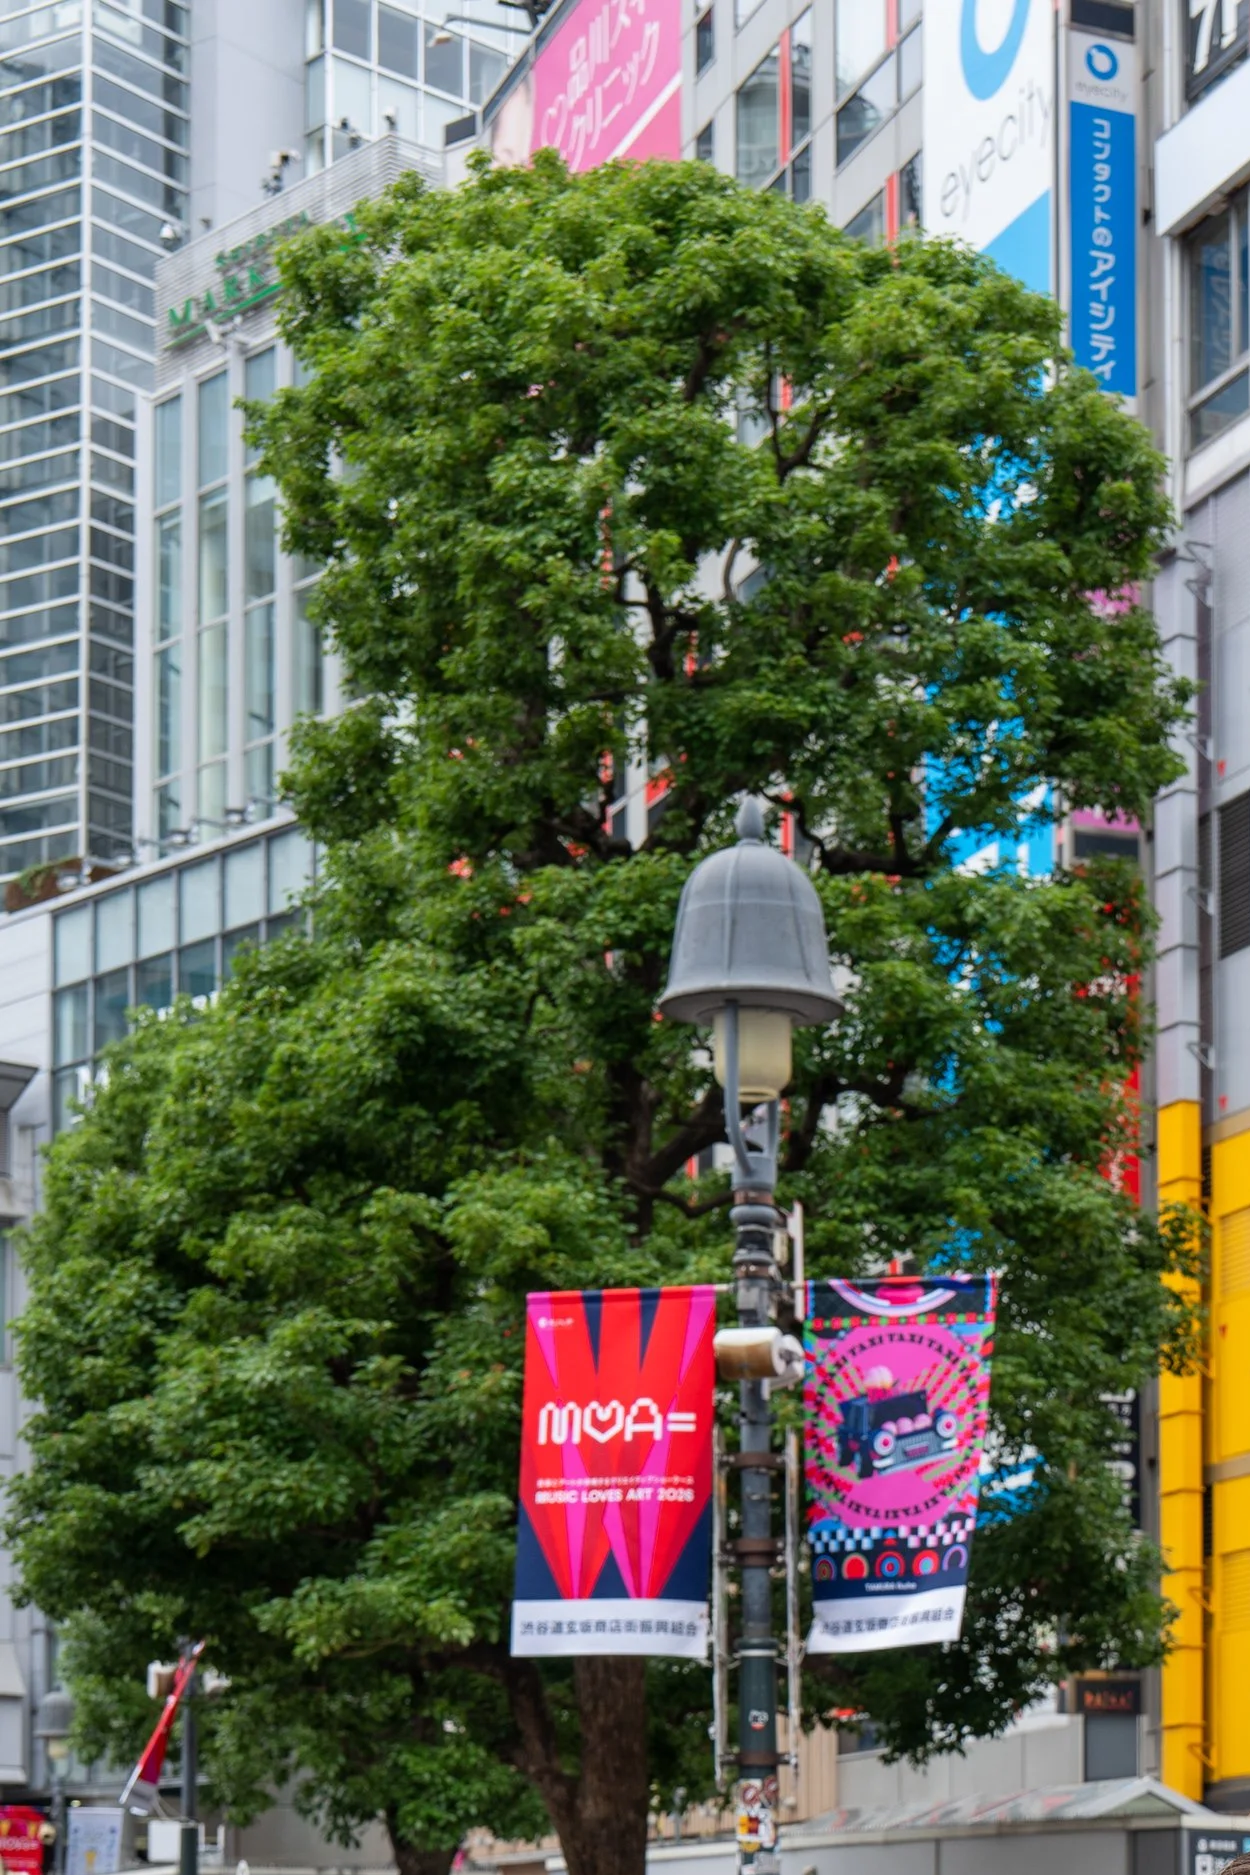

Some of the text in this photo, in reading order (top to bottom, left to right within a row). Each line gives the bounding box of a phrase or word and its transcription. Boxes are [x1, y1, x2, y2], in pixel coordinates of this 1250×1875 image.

[940, 78, 1052, 224] eyecity
[1089, 117, 1117, 381] コンタクトのアイシティ
[889, 1332, 924, 1344] TAXI
[535, 1489, 579, 1505] MUSIC
[581, 1487, 623, 1503] LOVES
[625, 1487, 654, 1501] ART
